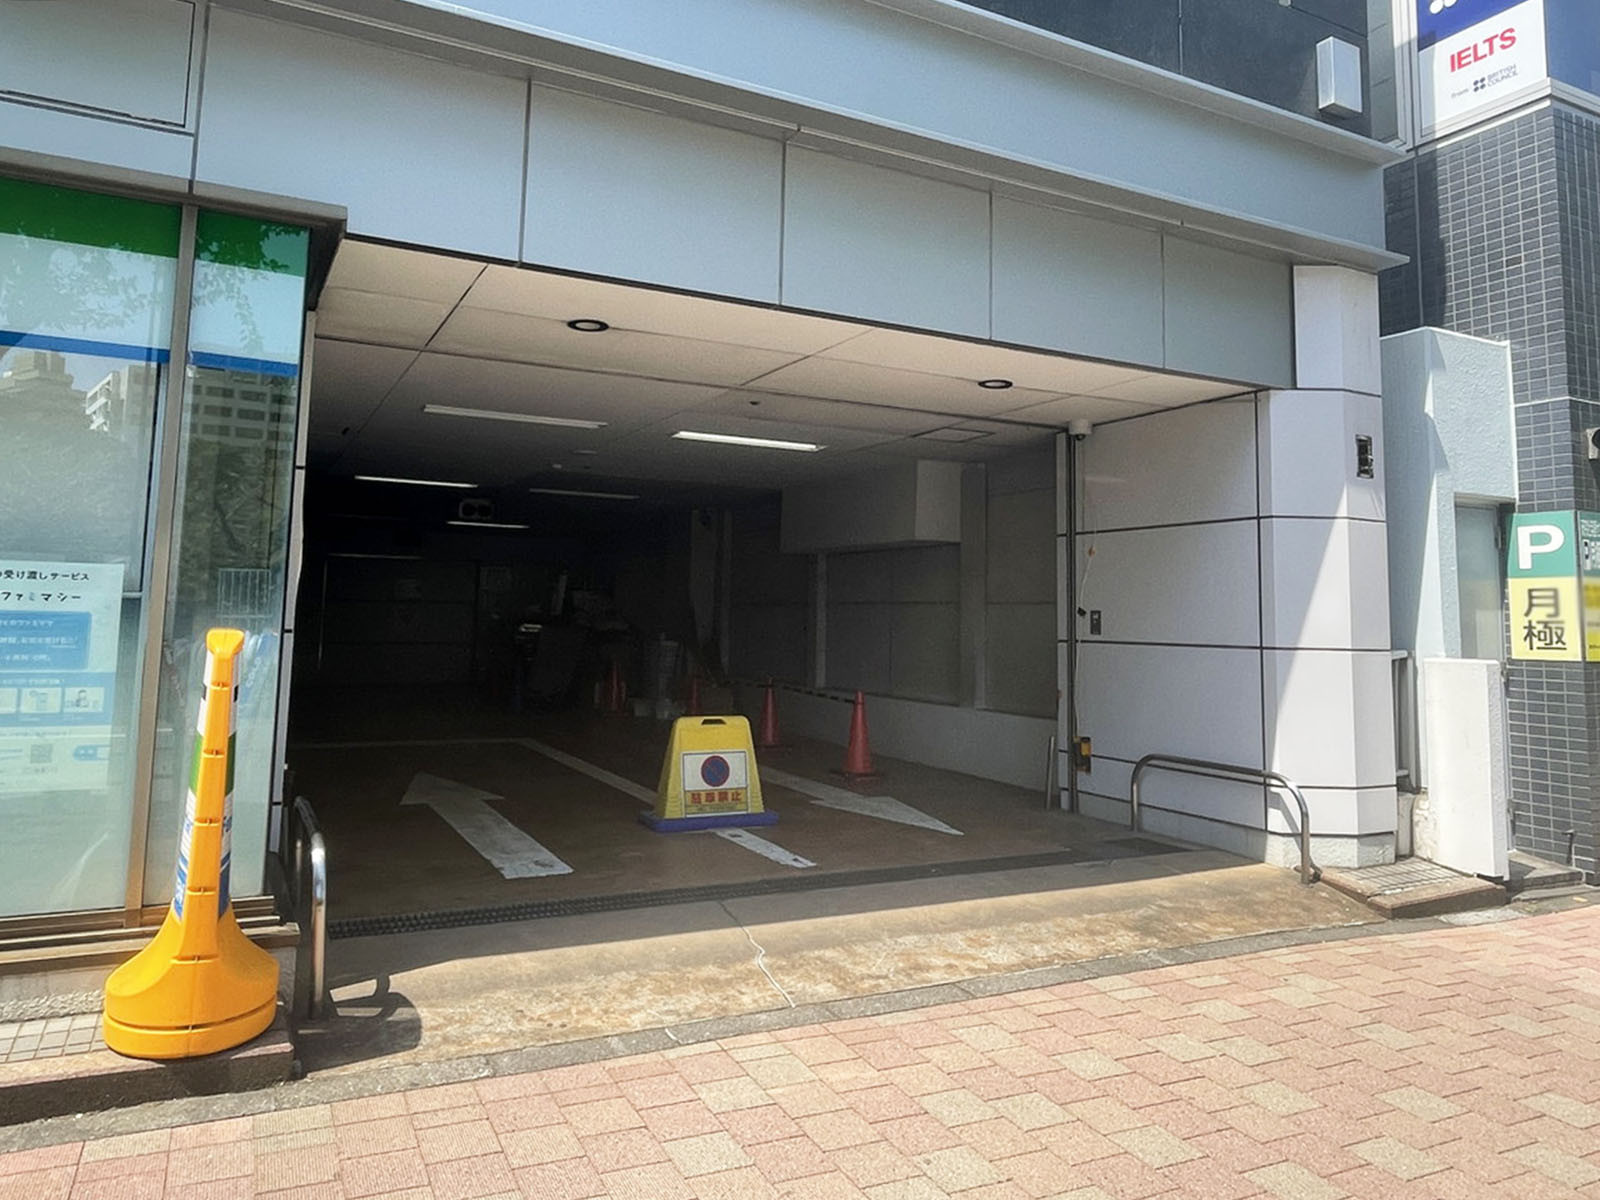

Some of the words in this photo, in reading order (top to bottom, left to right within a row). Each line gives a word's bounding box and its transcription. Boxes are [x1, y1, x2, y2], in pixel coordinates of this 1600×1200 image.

[1449, 27, 1517, 72] IELTS
[1517, 524, 1565, 570] P
[1523, 587, 1567, 651] 月極
